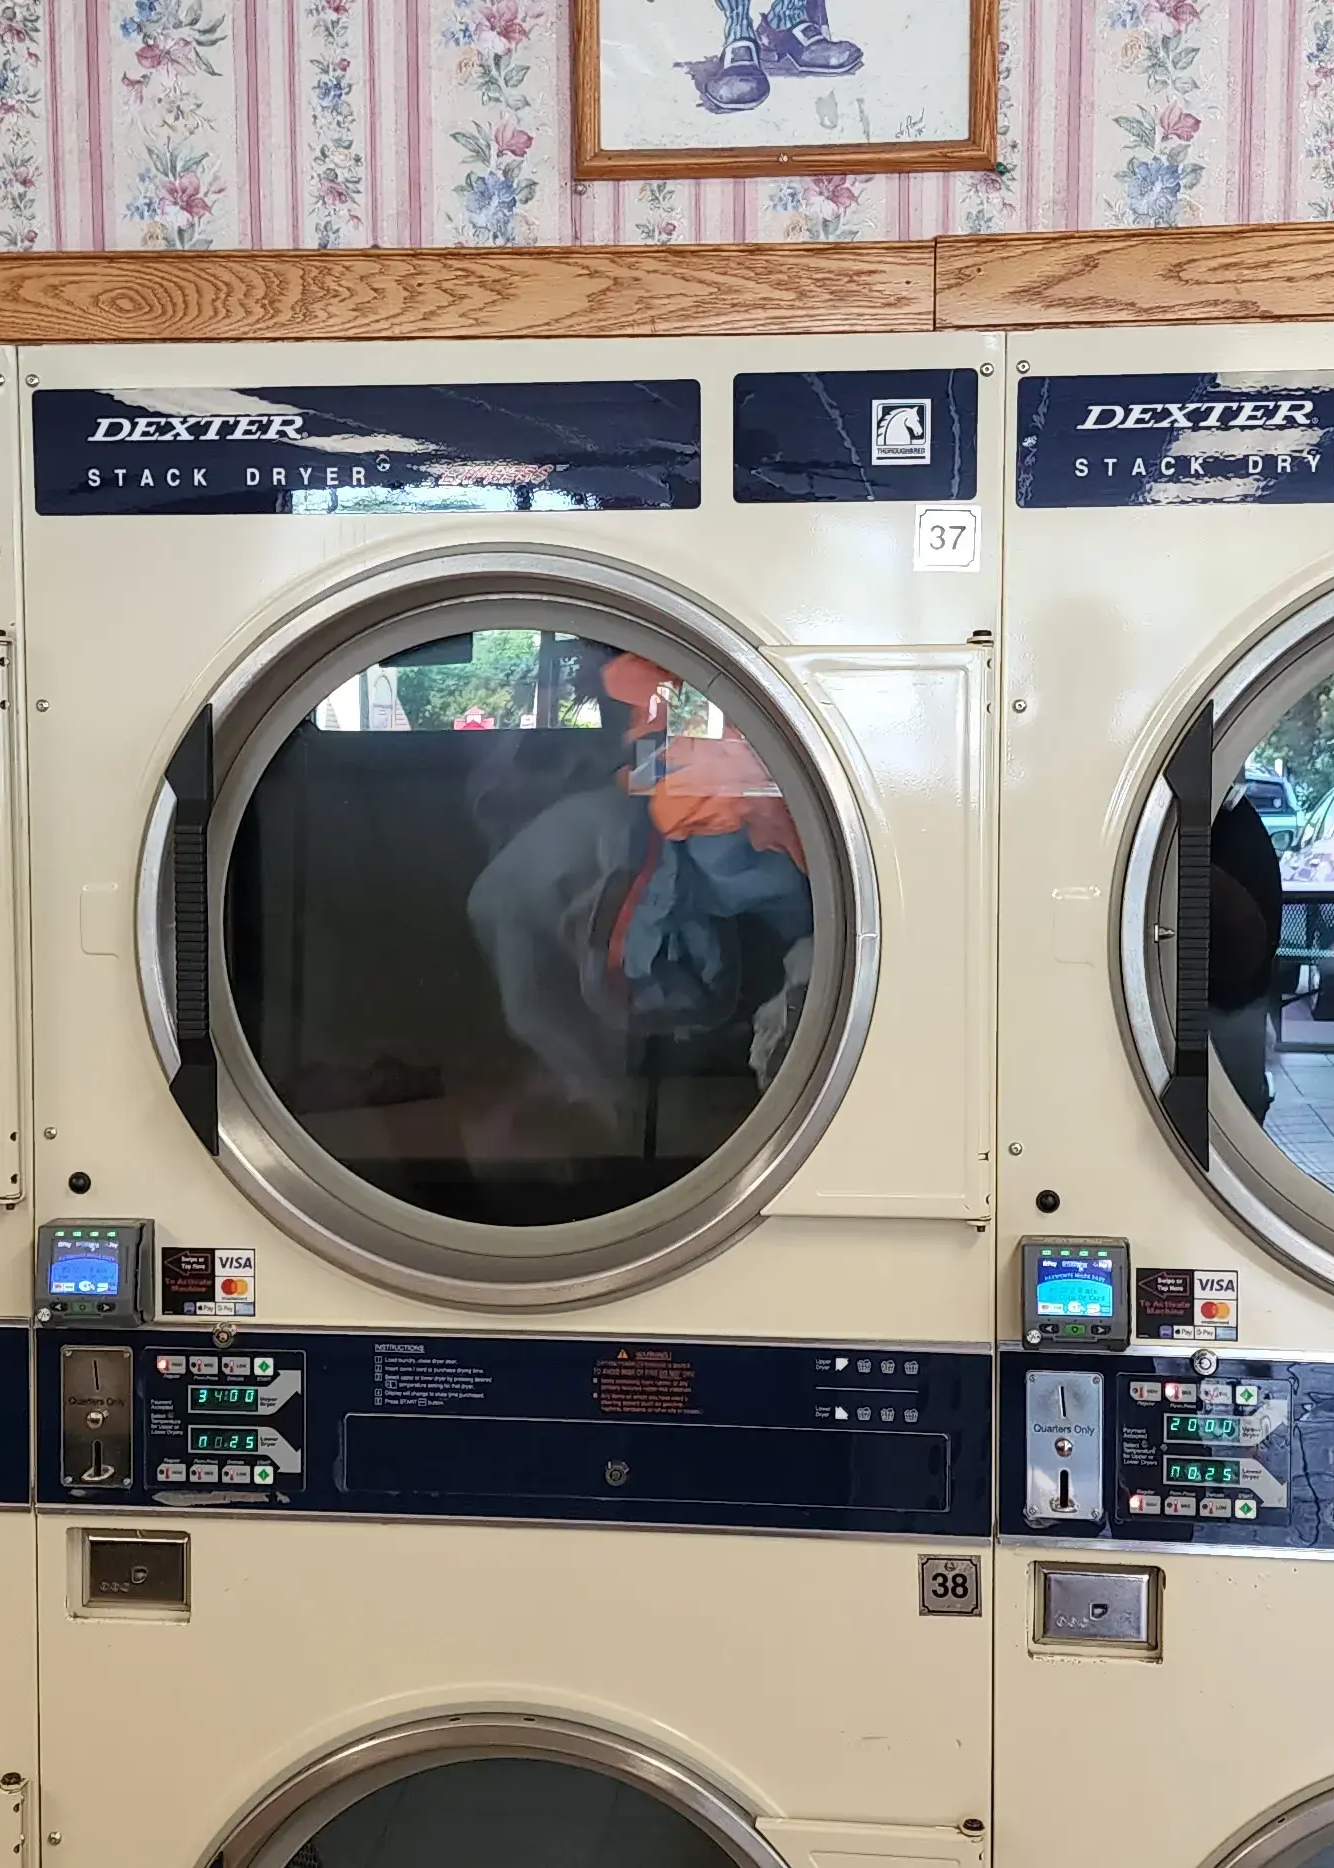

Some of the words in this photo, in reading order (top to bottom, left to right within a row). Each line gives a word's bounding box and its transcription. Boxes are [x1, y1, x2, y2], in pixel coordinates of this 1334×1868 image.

[1075, 400, 1315, 430] DEXTER
[87, 415, 305, 442] DEXTER
[87, 467, 208, 487] STACK
[246, 466, 367, 486] DRYER
[1074, 455, 1205, 477] STACK
[929, 524, 967, 551] 37
[218, 1256, 253, 1269] VISA
[1196, 1277, 1235, 1292] VISA
[1033, 1424, 1071, 1435] Quarters
[1074, 1424, 1095, 1437] Only
[930, 1572, 969, 1599] 38
